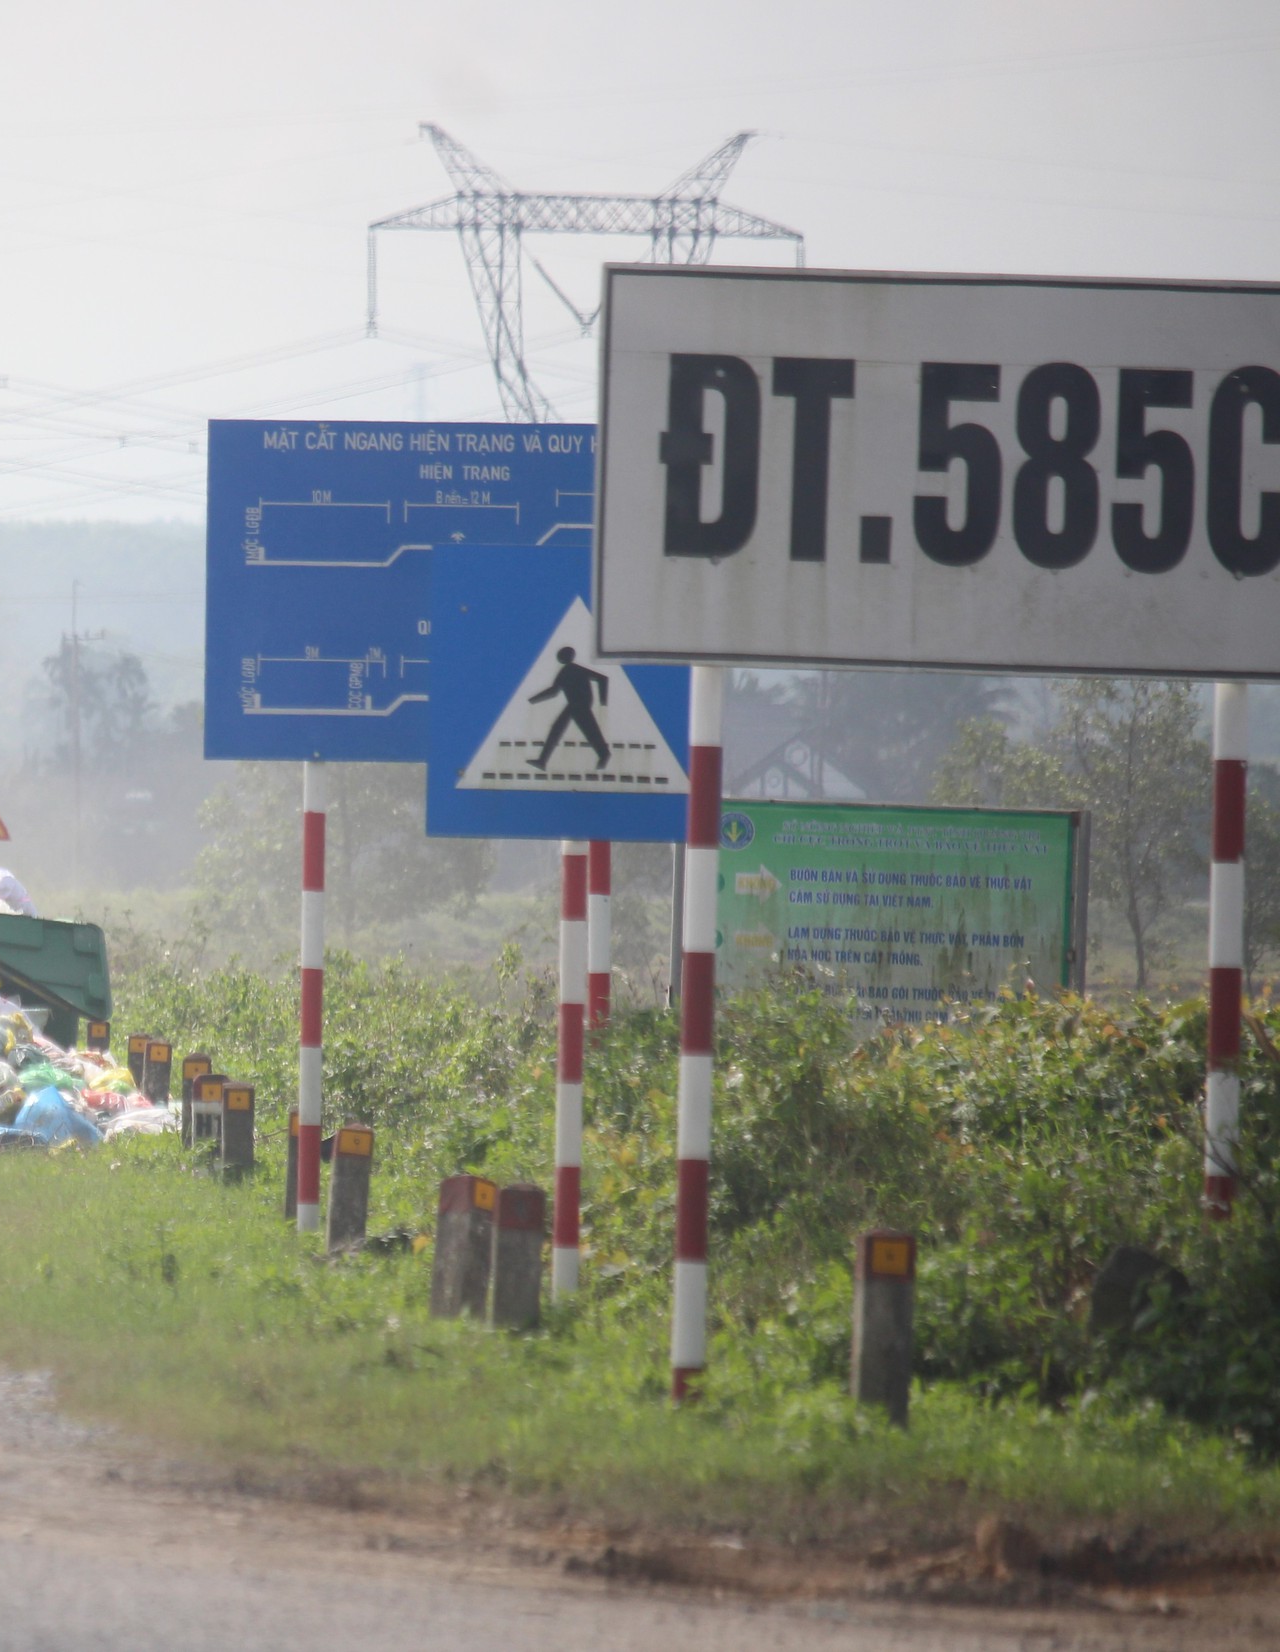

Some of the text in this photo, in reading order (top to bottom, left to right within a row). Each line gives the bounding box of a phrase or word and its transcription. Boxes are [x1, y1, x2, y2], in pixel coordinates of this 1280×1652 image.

[263, 427, 299, 453] MẶT
[305, 424, 337, 450] CẮT
[344, 431, 404, 451] NGANG
[410, 429, 450, 455] HIỆN
[456, 433, 515, 456] TRẠNG
[523, 430, 543, 453] VÀ
[548, 434, 583, 454] QUY
[420, 462, 511, 483] HIỆN TRẠNG
[659, 352, 1280, 578] ĐT.585C
